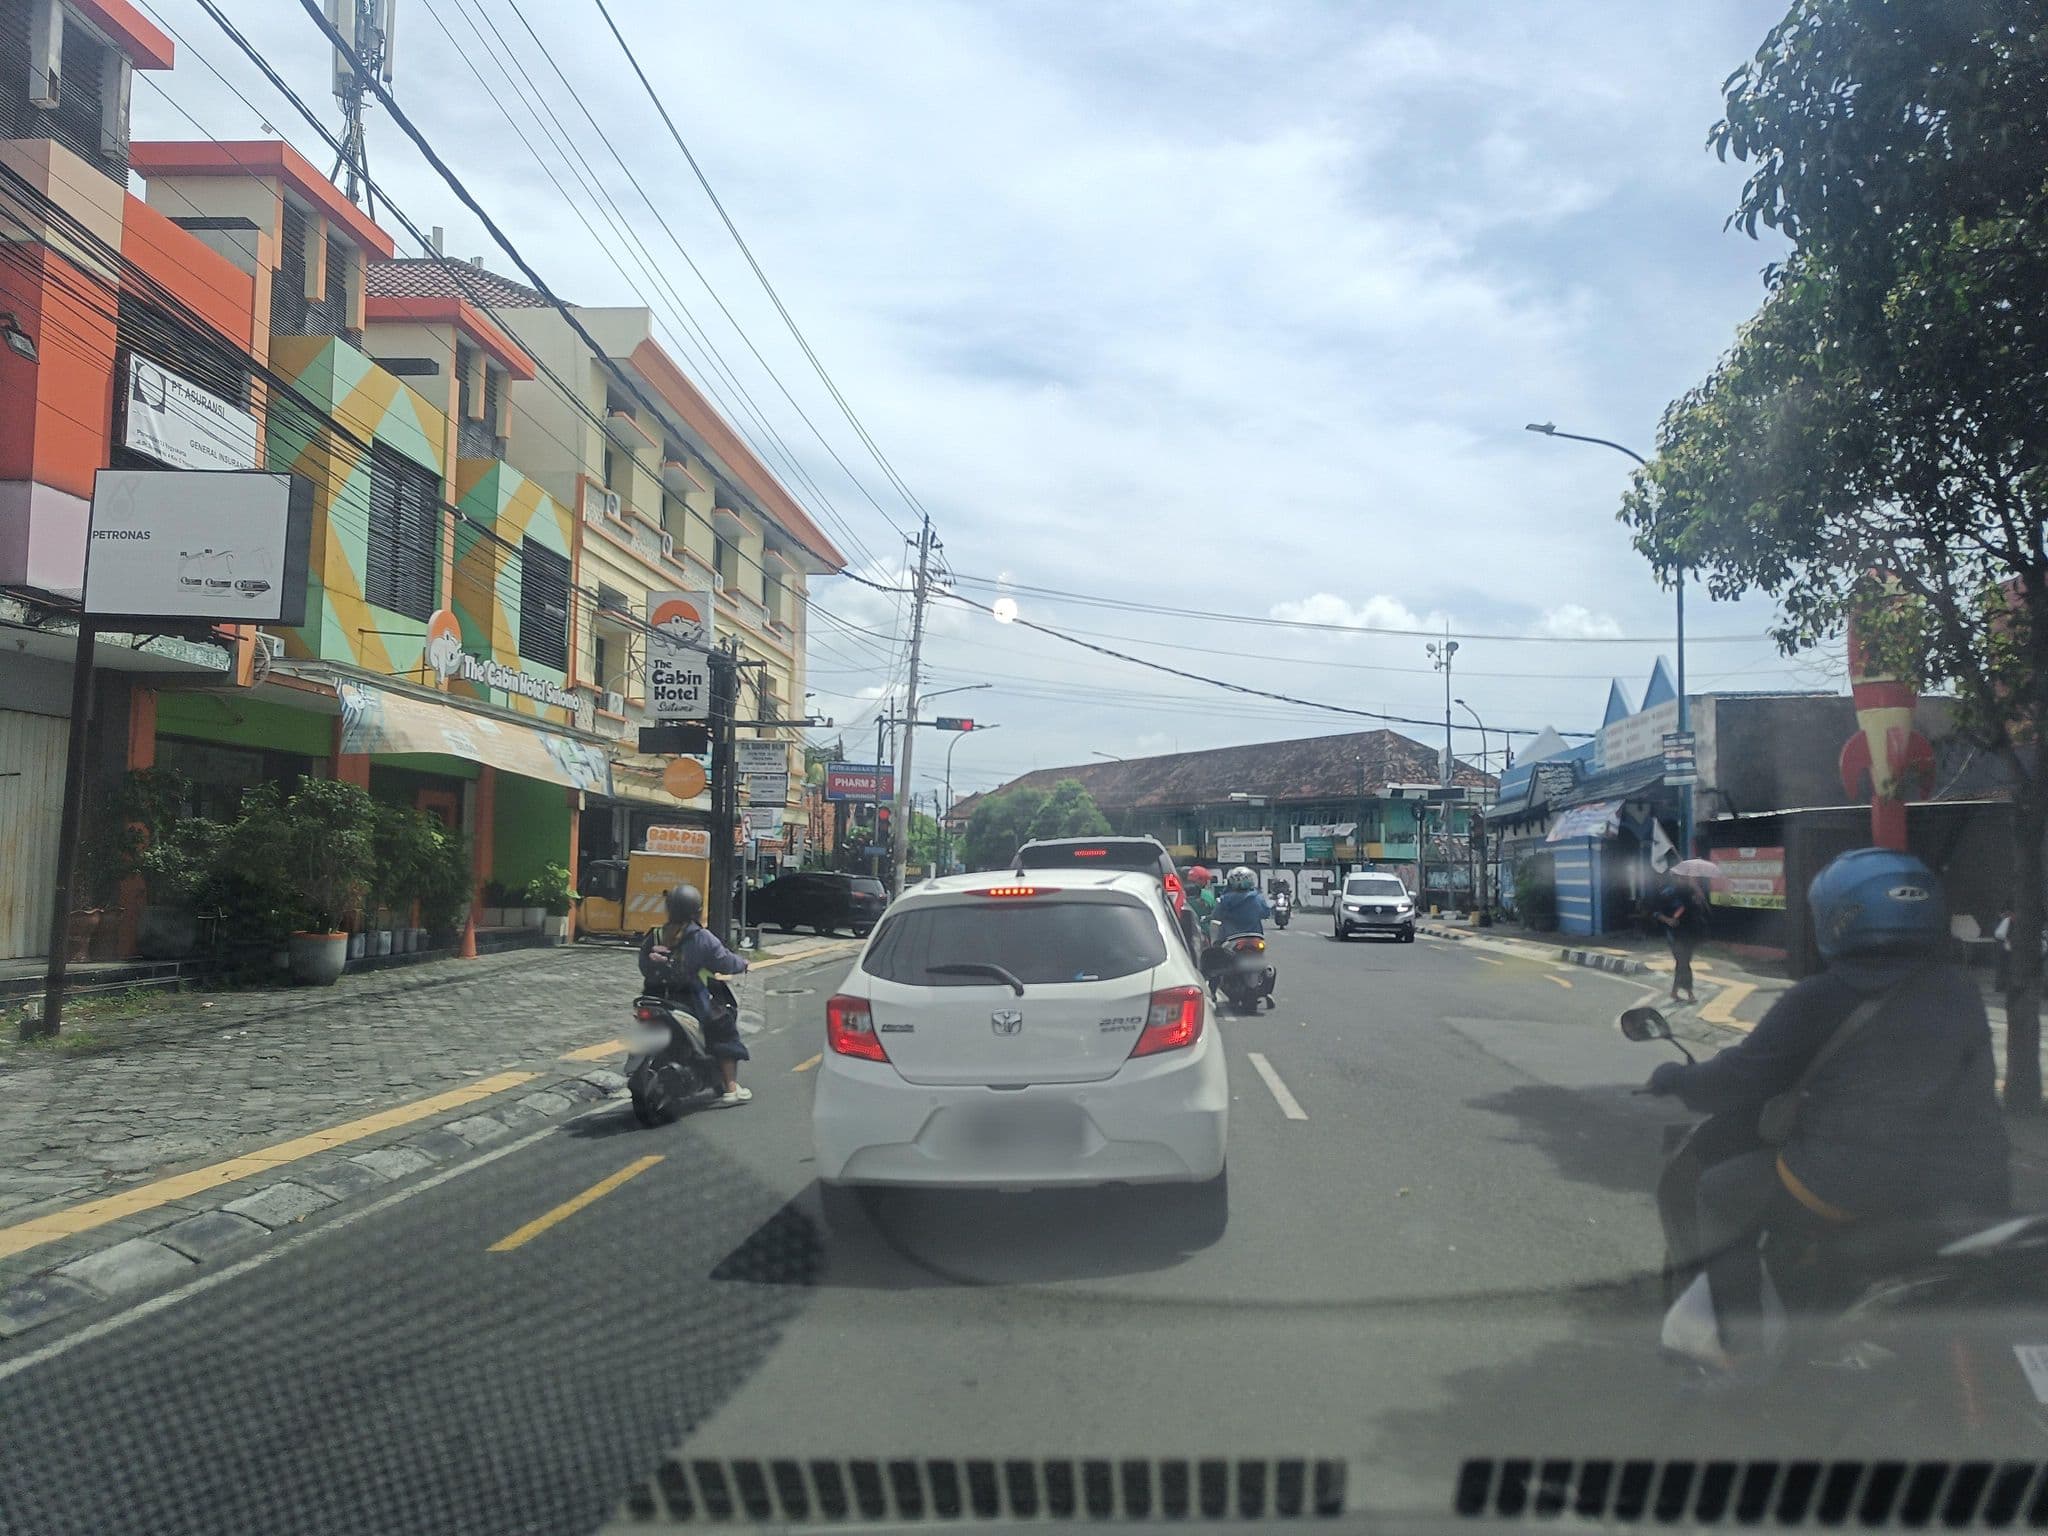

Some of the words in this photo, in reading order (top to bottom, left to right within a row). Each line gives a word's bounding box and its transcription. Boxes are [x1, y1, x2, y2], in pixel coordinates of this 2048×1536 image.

[185, 388, 225, 417] ASURANSI
[190, 439, 218, 459] GENERAL
[92, 530, 151, 540] PETRONAS
[654, 659, 672, 669] The
[464, 655, 485, 682] The
[487, 660, 519, 692] Cabin
[520, 672, 545, 703] Hotel
[652, 669, 702, 685] Cabin
[654, 686, 698, 700] Hotel
[835, 778, 870, 788] PHARM
